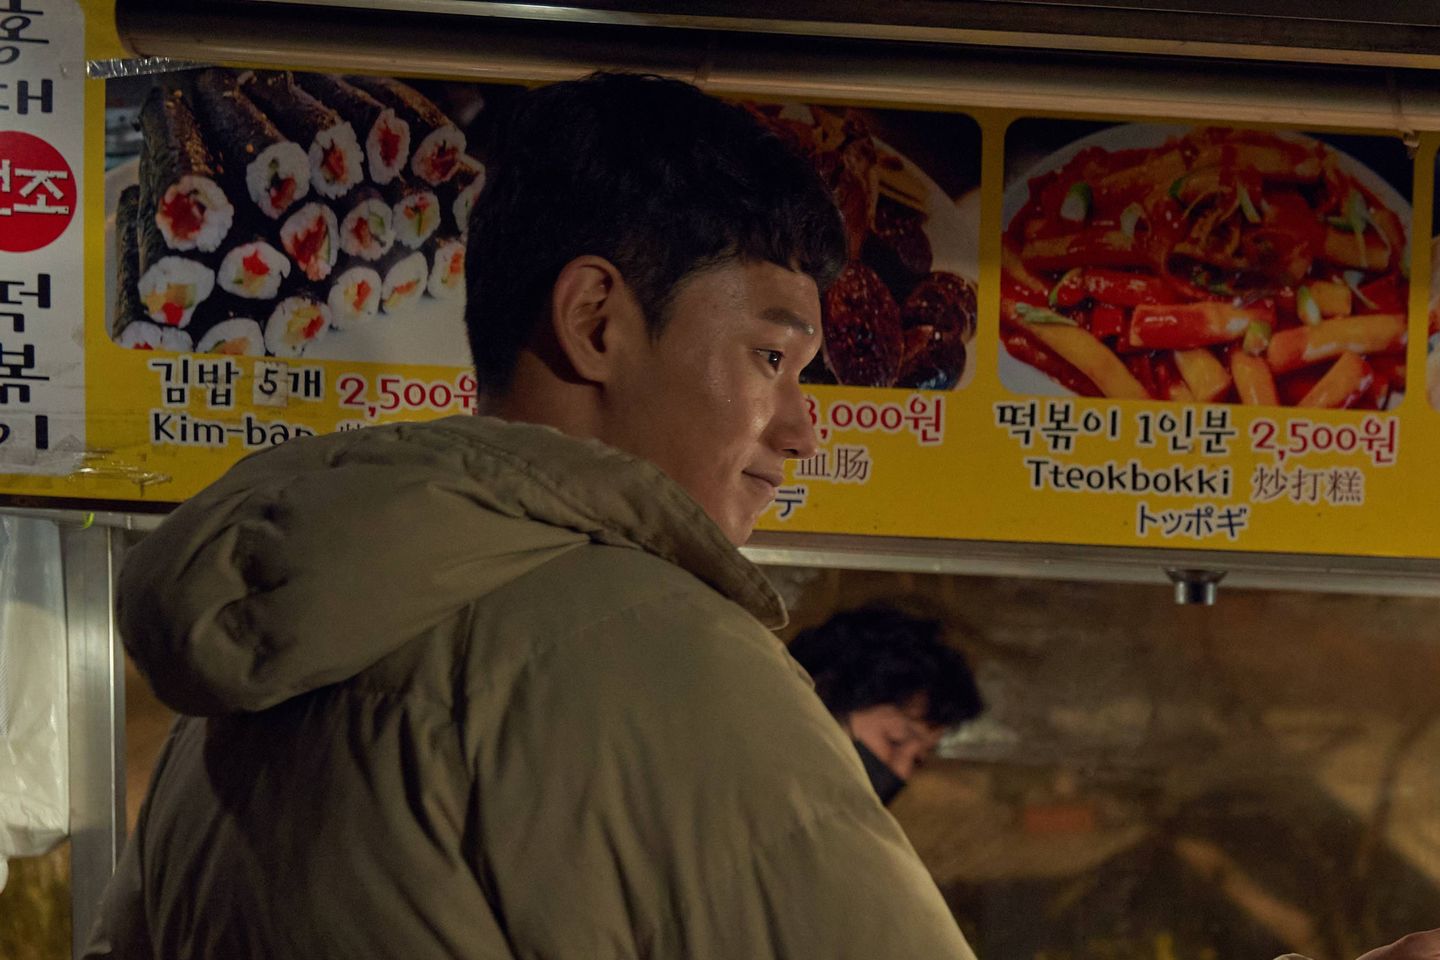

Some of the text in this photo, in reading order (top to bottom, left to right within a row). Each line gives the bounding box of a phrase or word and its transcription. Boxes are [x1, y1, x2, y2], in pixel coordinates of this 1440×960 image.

[0, 158, 70, 216] 조
[152, 359, 239, 407] 김밥
[258, 367, 322, 398] 5개
[996, 402, 1398, 463] 떡볶이 1인분 2,500원
[1027, 459, 1363, 504] Tteokbokki 炒打糕
